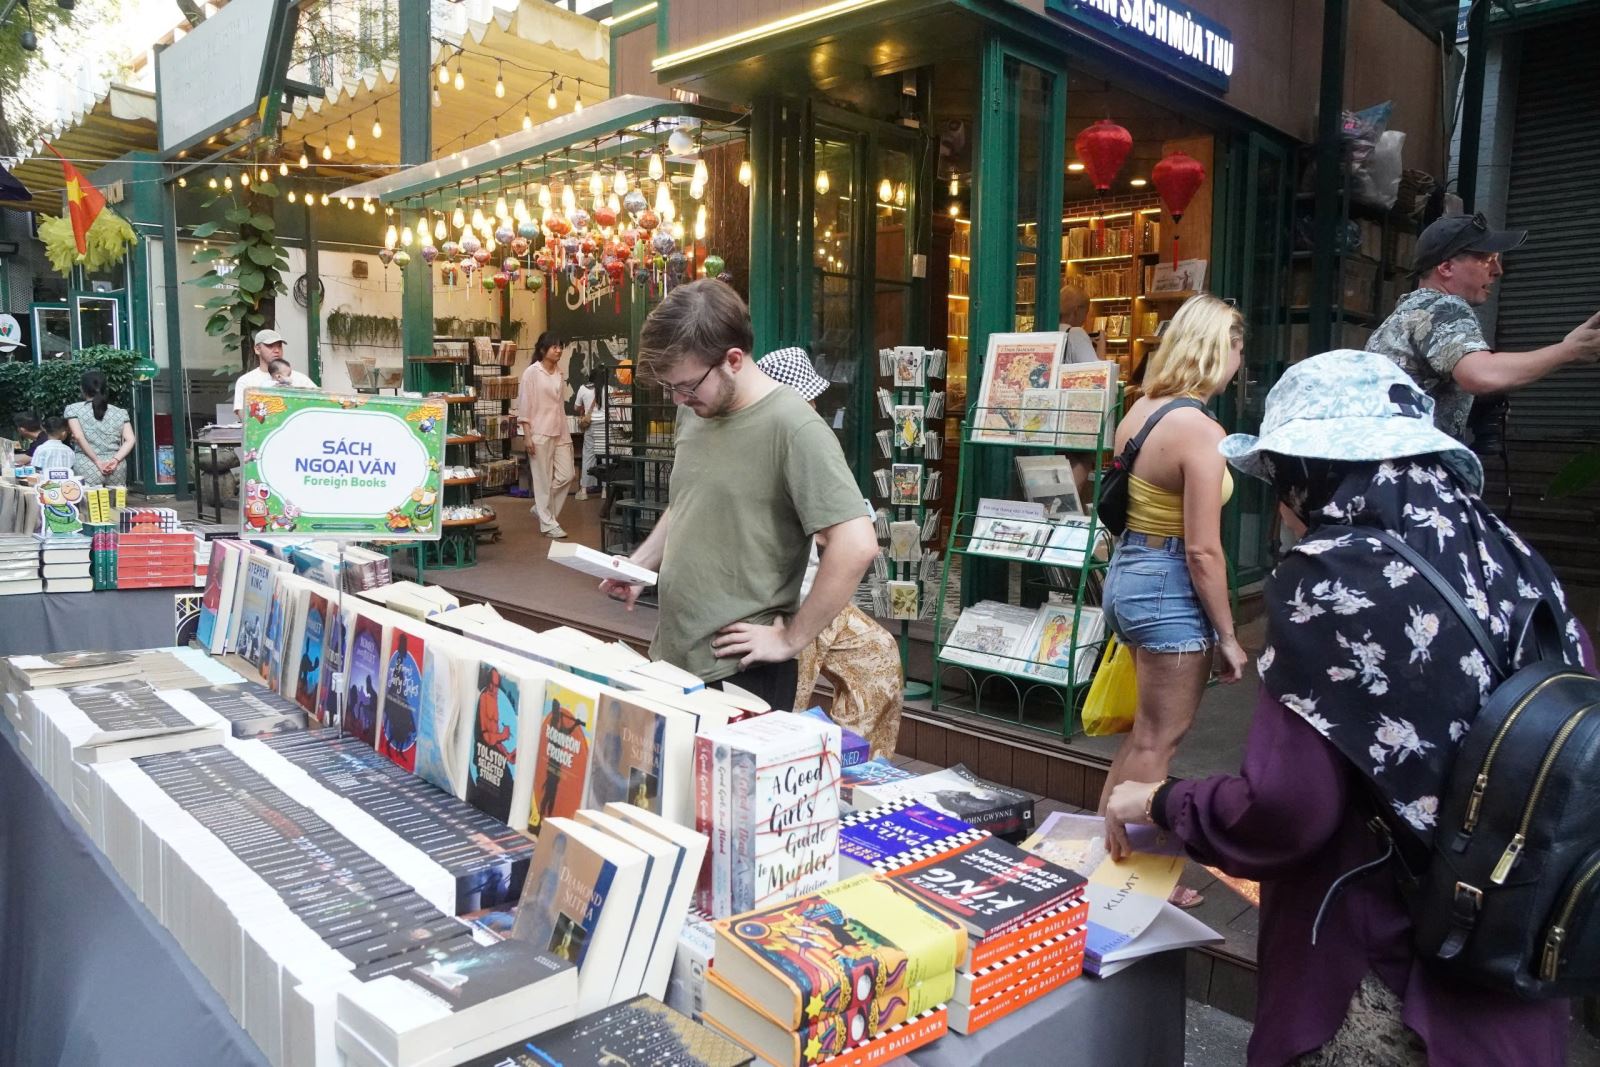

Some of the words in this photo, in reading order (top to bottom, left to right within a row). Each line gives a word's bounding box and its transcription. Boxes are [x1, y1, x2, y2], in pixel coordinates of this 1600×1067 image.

[1168, 11, 1203, 62] MÙA
[1205, 29, 1234, 76] THU
[322, 437, 373, 457] SÁCH
[295, 457, 354, 477] NGOẠI
[359, 458, 396, 476] VĂN
[303, 475, 349, 490] Foreign
[350, 477, 387, 489] Books
[248, 561, 270, 579] STEPHEN
[250, 576, 264, 591] KING
[545, 724, 581, 754] ROBINSON
[477, 743, 508, 770] TOLSTOY
[478, 757, 505, 779] SELECTED
[546, 742, 574, 769] CRUSOE
[631, 747, 661, 769] SUTRA
[480, 768, 501, 787] STORIES
[772, 776, 781, 795] A
[784, 753, 823, 795] Good
[769, 795, 814, 837] Girl's
[983, 808, 1013, 823] GWYNNE
[786, 823, 827, 858] Guide
[864, 823, 921, 846] DAILY
[881, 820, 931, 841] LAWS
[758, 863, 767, 878] to
[964, 853, 1058, 889] SHAWSHANK
[978, 848, 1068, 884] REDEMPTION
[560, 866, 602, 906] DIAMOND
[908, 876, 1000, 915] STEPHEN
[921, 868, 1025, 910] KING
[1103, 872, 1140, 912] KLIMT
[563, 892, 593, 921] SUTRA
[1028, 927, 1042, 941] THE
[1044, 919, 1065, 934] DAILY
[1067, 911, 1085, 924] LAWS
[1027, 958, 1041, 970] THE
[1043, 948, 1063, 963] DAILY
[1065, 938, 1083, 952] LAWS
[1024, 984, 1038, 997] THE
[1040, 975, 1060, 989] DAILY
[1062, 963, 1079, 977] LAWS
[867, 1046, 886, 1061] THE
[889, 1032, 917, 1052] DAILY
[919, 1022, 943, 1037] LAWS
